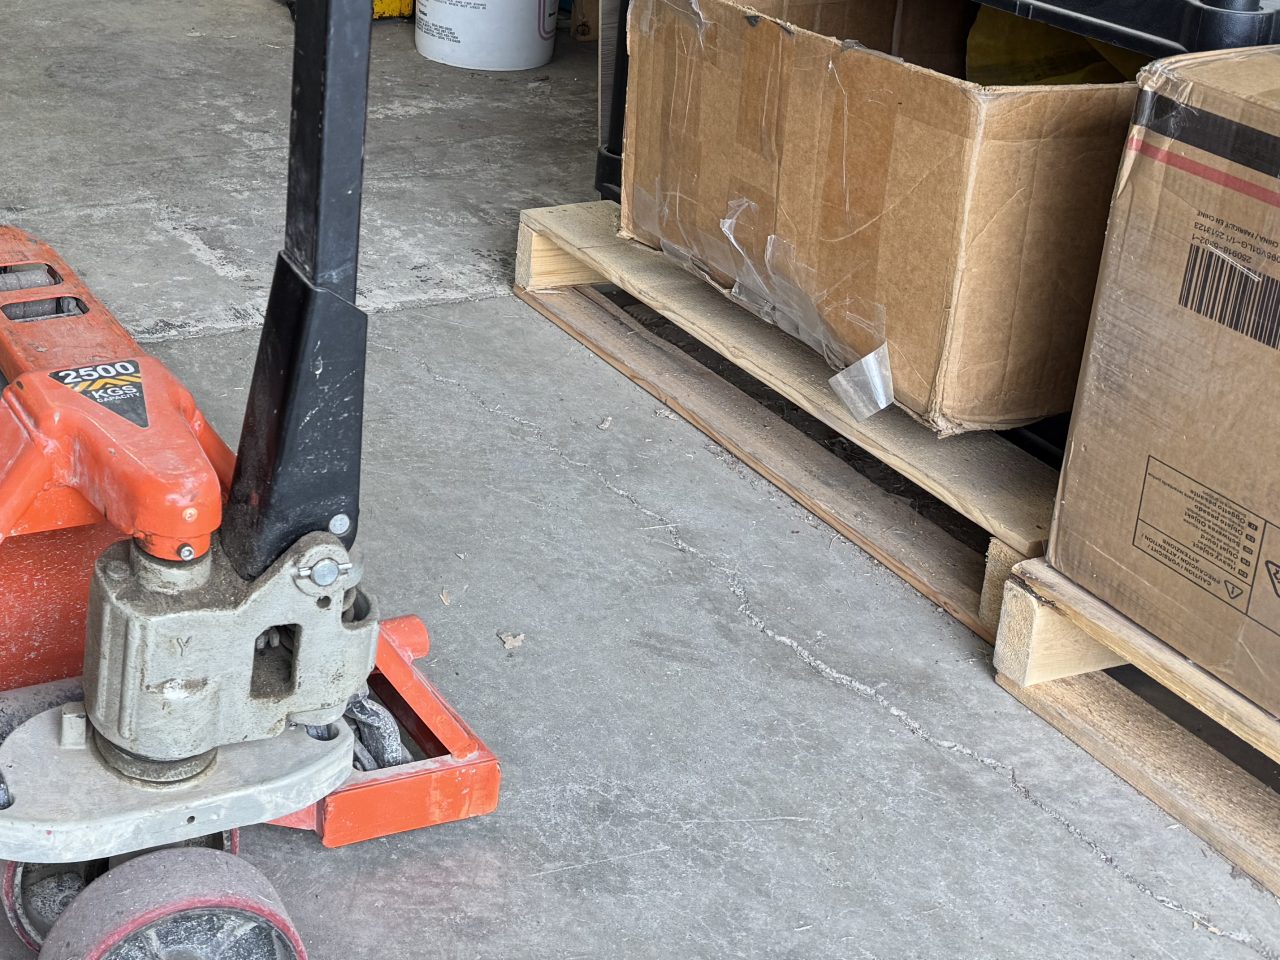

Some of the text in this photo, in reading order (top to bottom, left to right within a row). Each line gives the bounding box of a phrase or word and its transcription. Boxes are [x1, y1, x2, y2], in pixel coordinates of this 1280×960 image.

[1194, 222, 1224, 239] 2513123
[1216, 218, 1224, 226] EN
[1260, 235, 1278, 248] CHINA
[58, 362, 135, 384] 2500
[91, 385, 137, 398] KGS
[96, 392, 140, 403] CAPACITY
[1190, 489, 1216, 508] pesante
[1184, 511, 1206, 527] Objekt
[1194, 504, 1219, 520] pesado
[1218, 505, 1246, 524] Oggetto
[1207, 521, 1240, 548] Schweres
[1221, 520, 1243, 536] Objeto
[1144, 535, 1177, 558] ATTENTION
[1192, 540, 1214, 557] object.
[1200, 534, 1218, 548] lourd
[1150, 546, 1180, 568] VORSICHT
[1162, 539, 1200, 563] ATTENZIONE
[1222, 547, 1238, 560] Objet
[1215, 554, 1236, 572] Heavy
[1184, 566, 1211, 586] CAUTION
